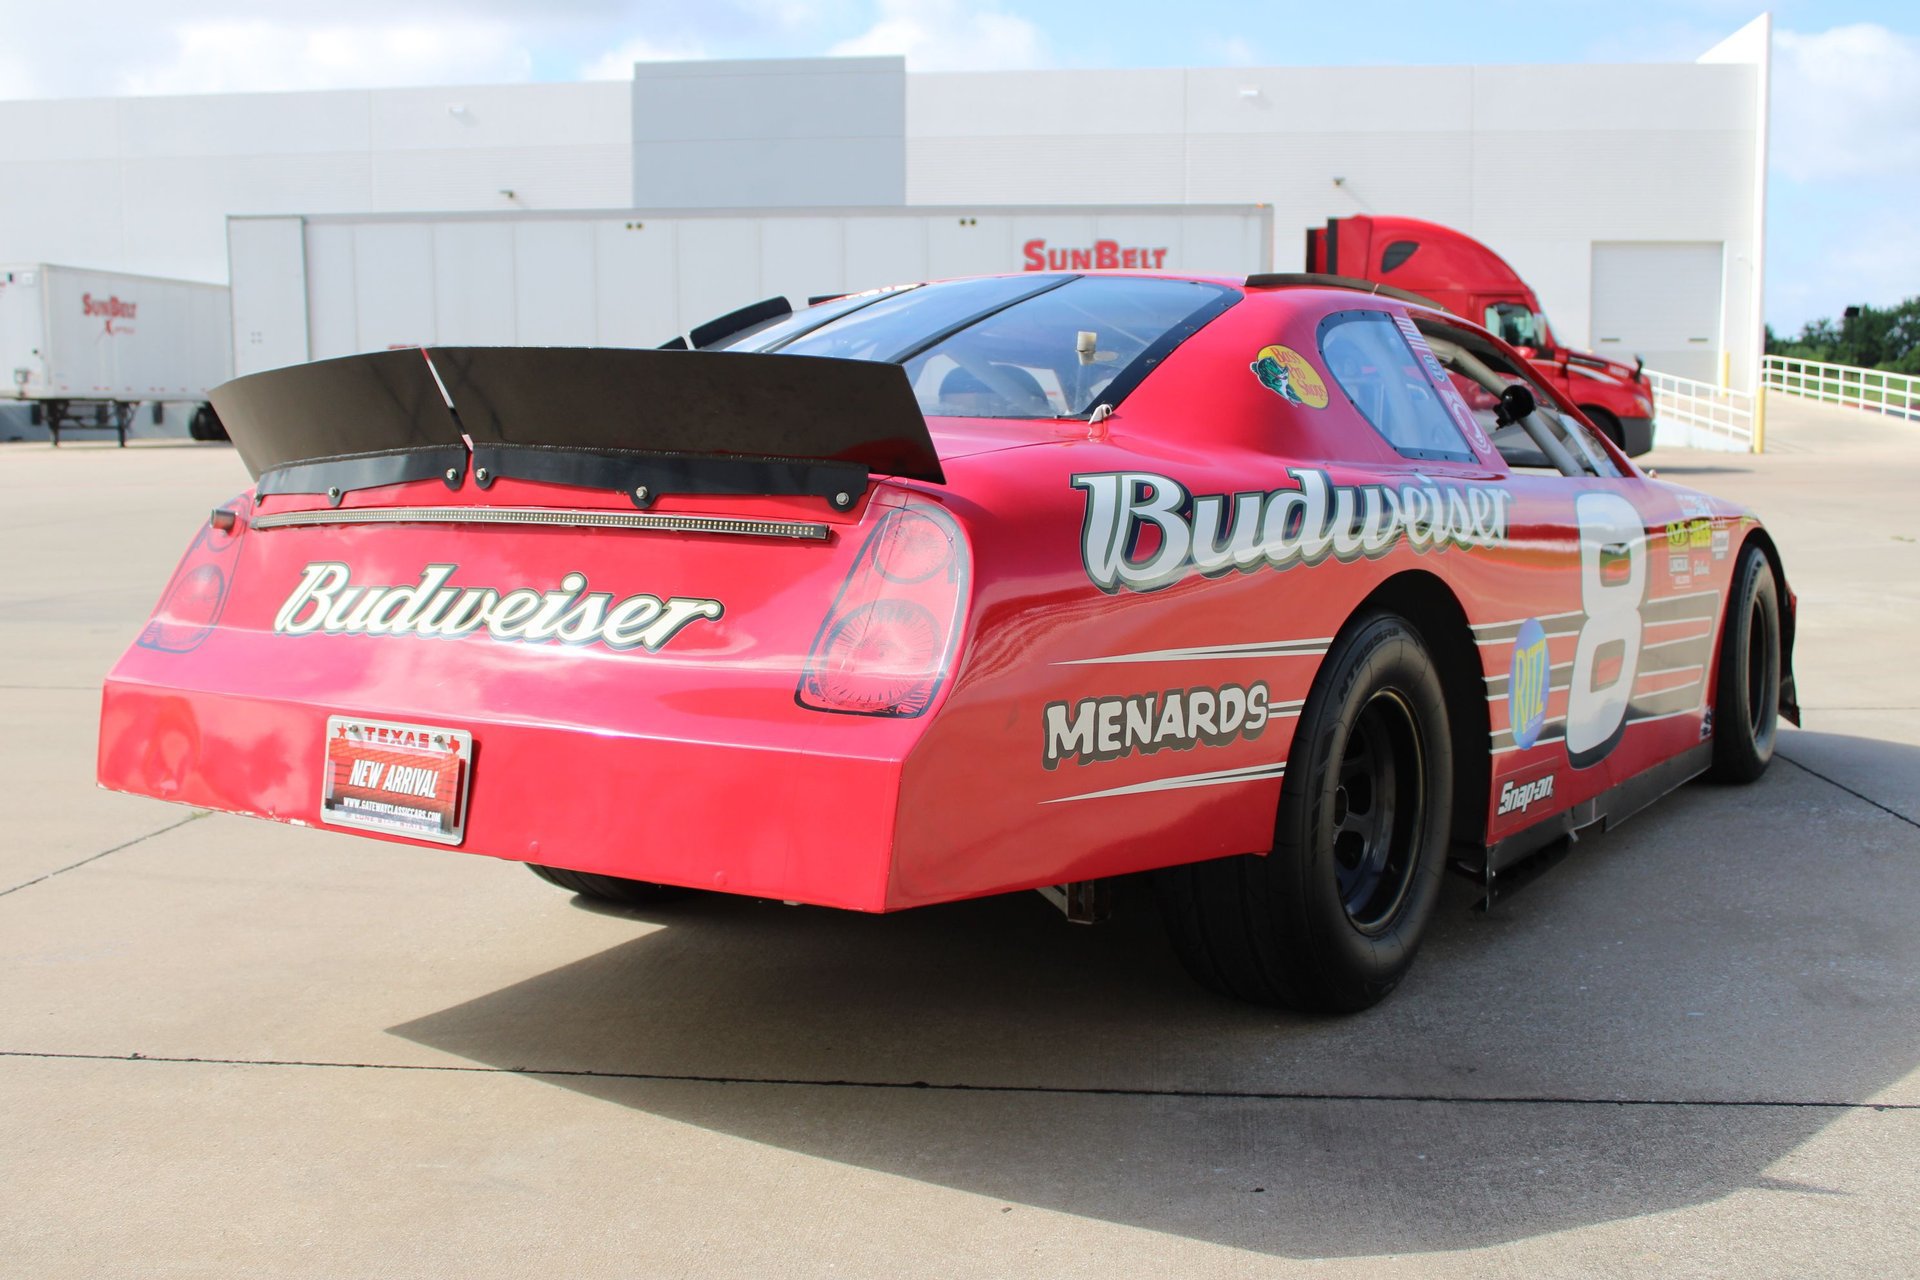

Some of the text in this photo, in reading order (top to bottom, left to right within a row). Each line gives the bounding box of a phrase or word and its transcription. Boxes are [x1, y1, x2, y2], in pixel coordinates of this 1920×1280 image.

[1070, 467, 1518, 595] Budweiser
[273, 561, 726, 653] Budweiser
[1566, 491, 1646, 765] 8
[364, 727, 430, 748] TEXAS
[1043, 681, 1270, 768] MENARDS
[348, 759, 439, 799] NEW ARRIVAL
[1497, 775, 1554, 816] Snap-on
